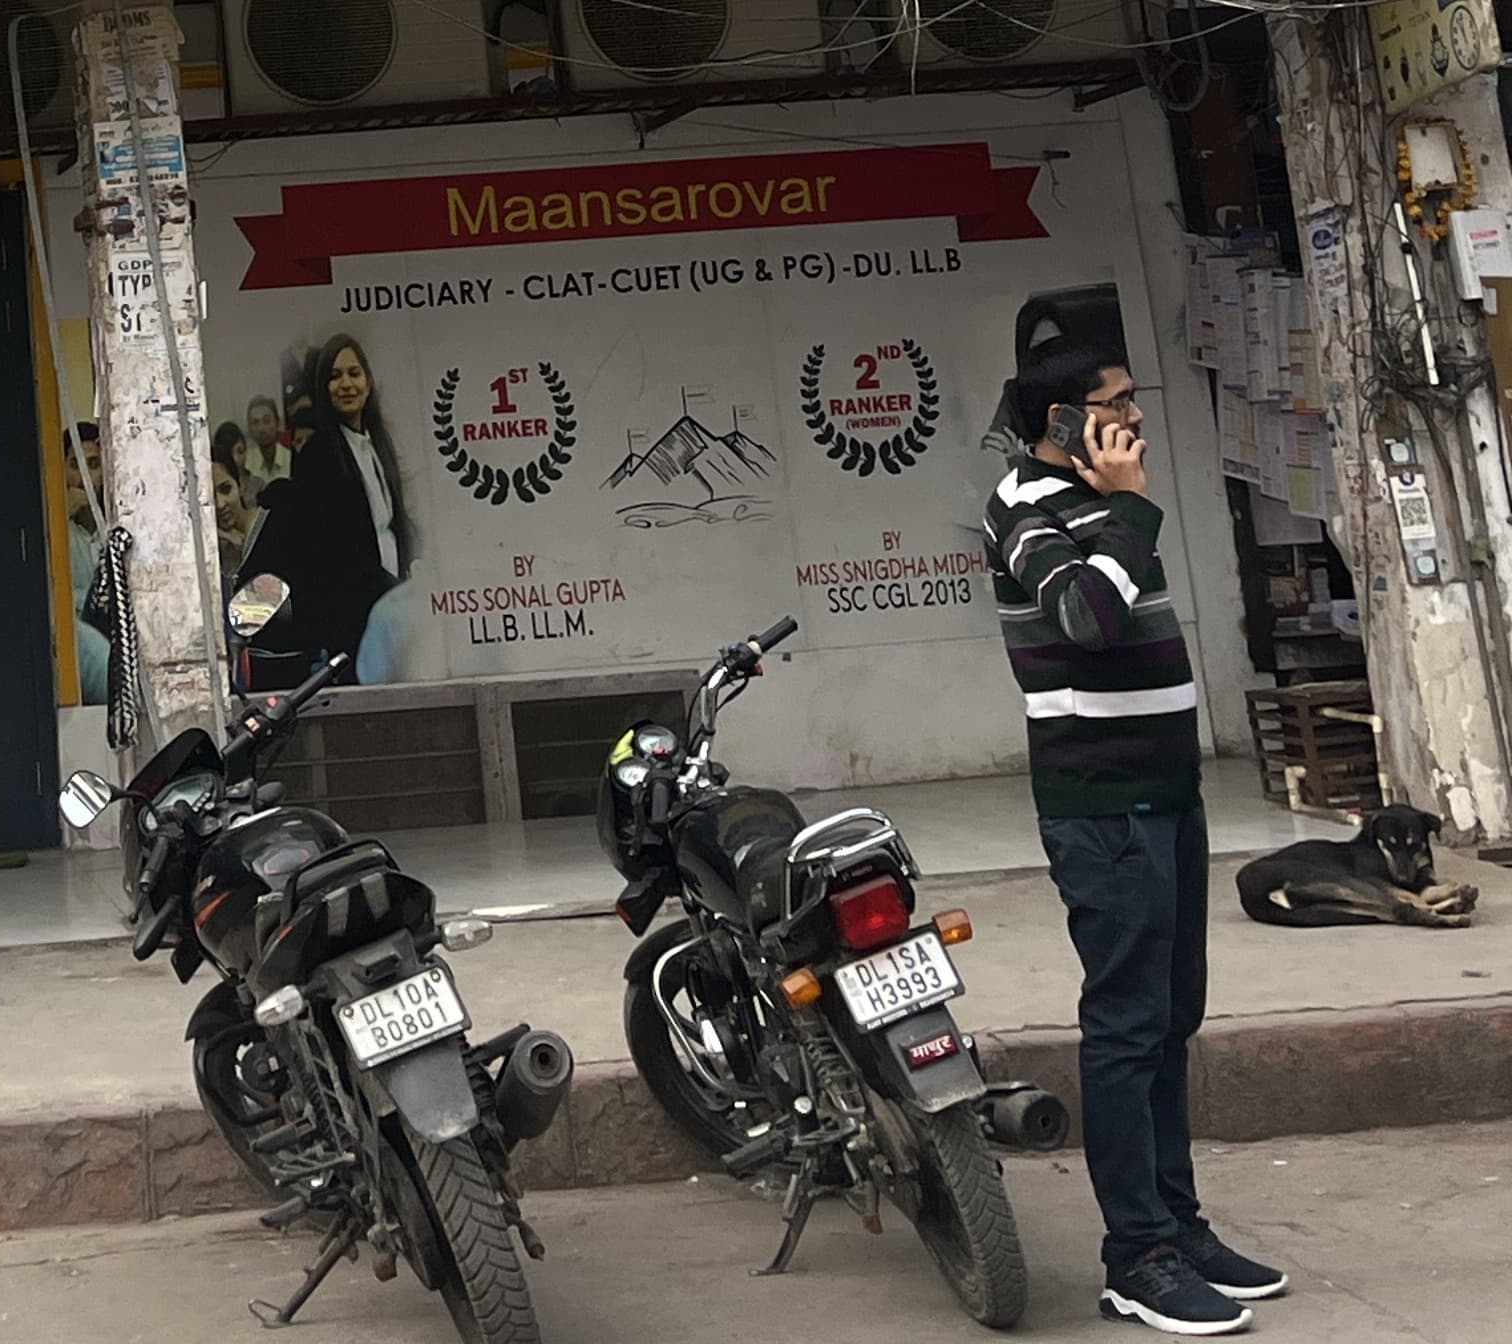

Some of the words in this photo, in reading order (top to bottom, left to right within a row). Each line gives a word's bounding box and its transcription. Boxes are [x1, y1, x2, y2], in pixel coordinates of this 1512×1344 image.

[446, 176, 836, 239] Maansarovar
[340, 278, 493, 314] JUDICIARY
[689, 257, 744, 292] (UG
[754, 257, 774, 283] &
[783, 252, 836, 282] PG)
[910, 246, 963, 276] LL.B
[829, 393, 913, 417] RANKER
[462, 418, 549, 442] RANKER
[845, 415, 902, 431] (WOMEN)
[881, 531, 902, 551] BY
[513, 555, 535, 578] BY
[796, 563, 842, 588] MISS
[844, 559, 930, 584] SNIGDHA
[430, 588, 479, 616] MISS
[483, 583, 552, 611] SONAL
[555, 578, 626, 605] GUPTA
[828, 584, 868, 613] SSC
[873, 582, 918, 610] CGL
[921, 578, 972, 606] 2013
[866, 966, 943, 1013] H3993
